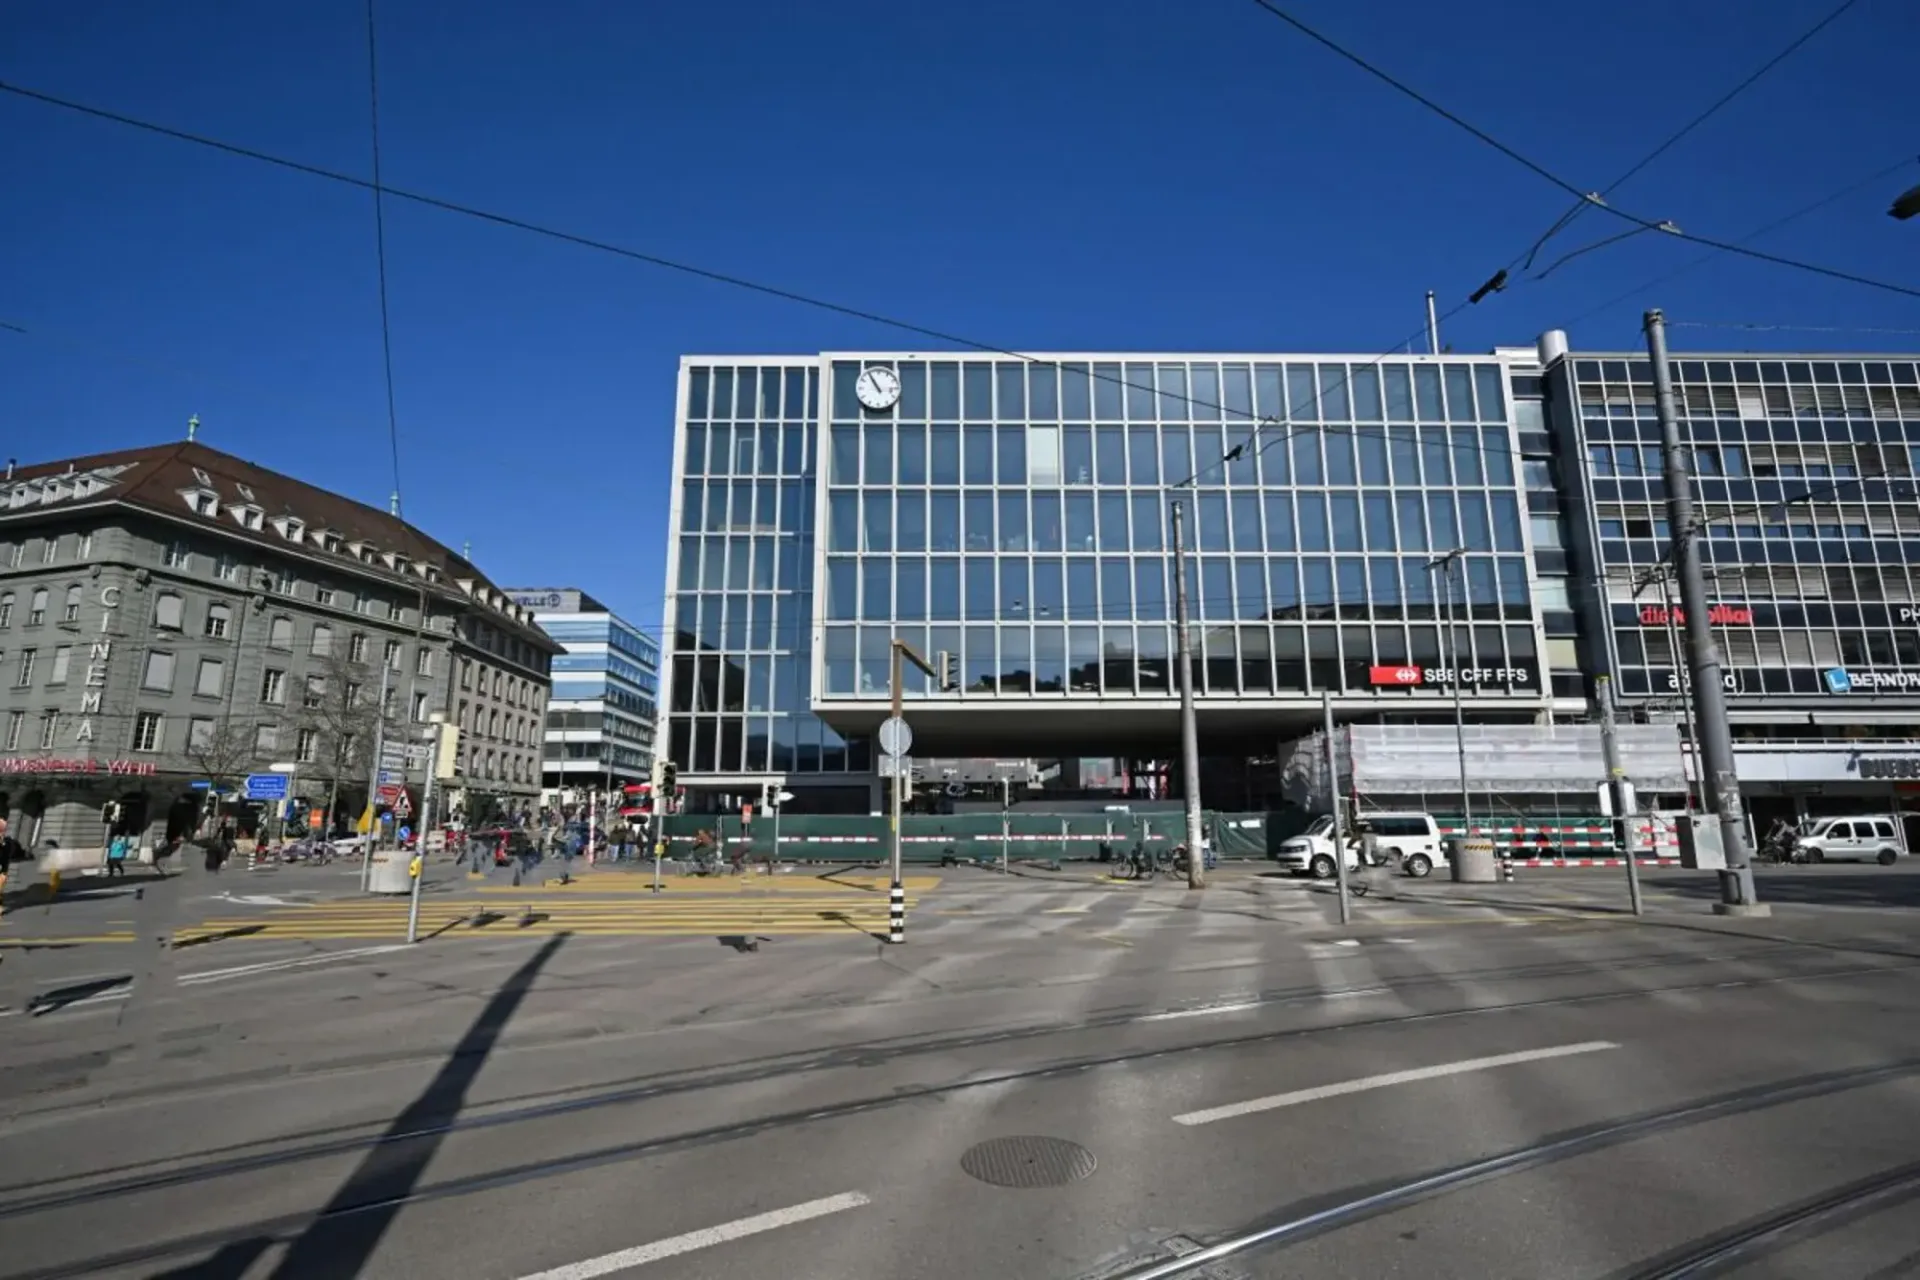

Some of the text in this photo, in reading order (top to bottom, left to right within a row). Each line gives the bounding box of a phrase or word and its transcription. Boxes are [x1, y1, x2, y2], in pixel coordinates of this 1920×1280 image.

[76, 586, 122, 742] CINEMA
[1461, 668, 1493, 683] CFF
[1496, 668, 1529, 683] FFS
